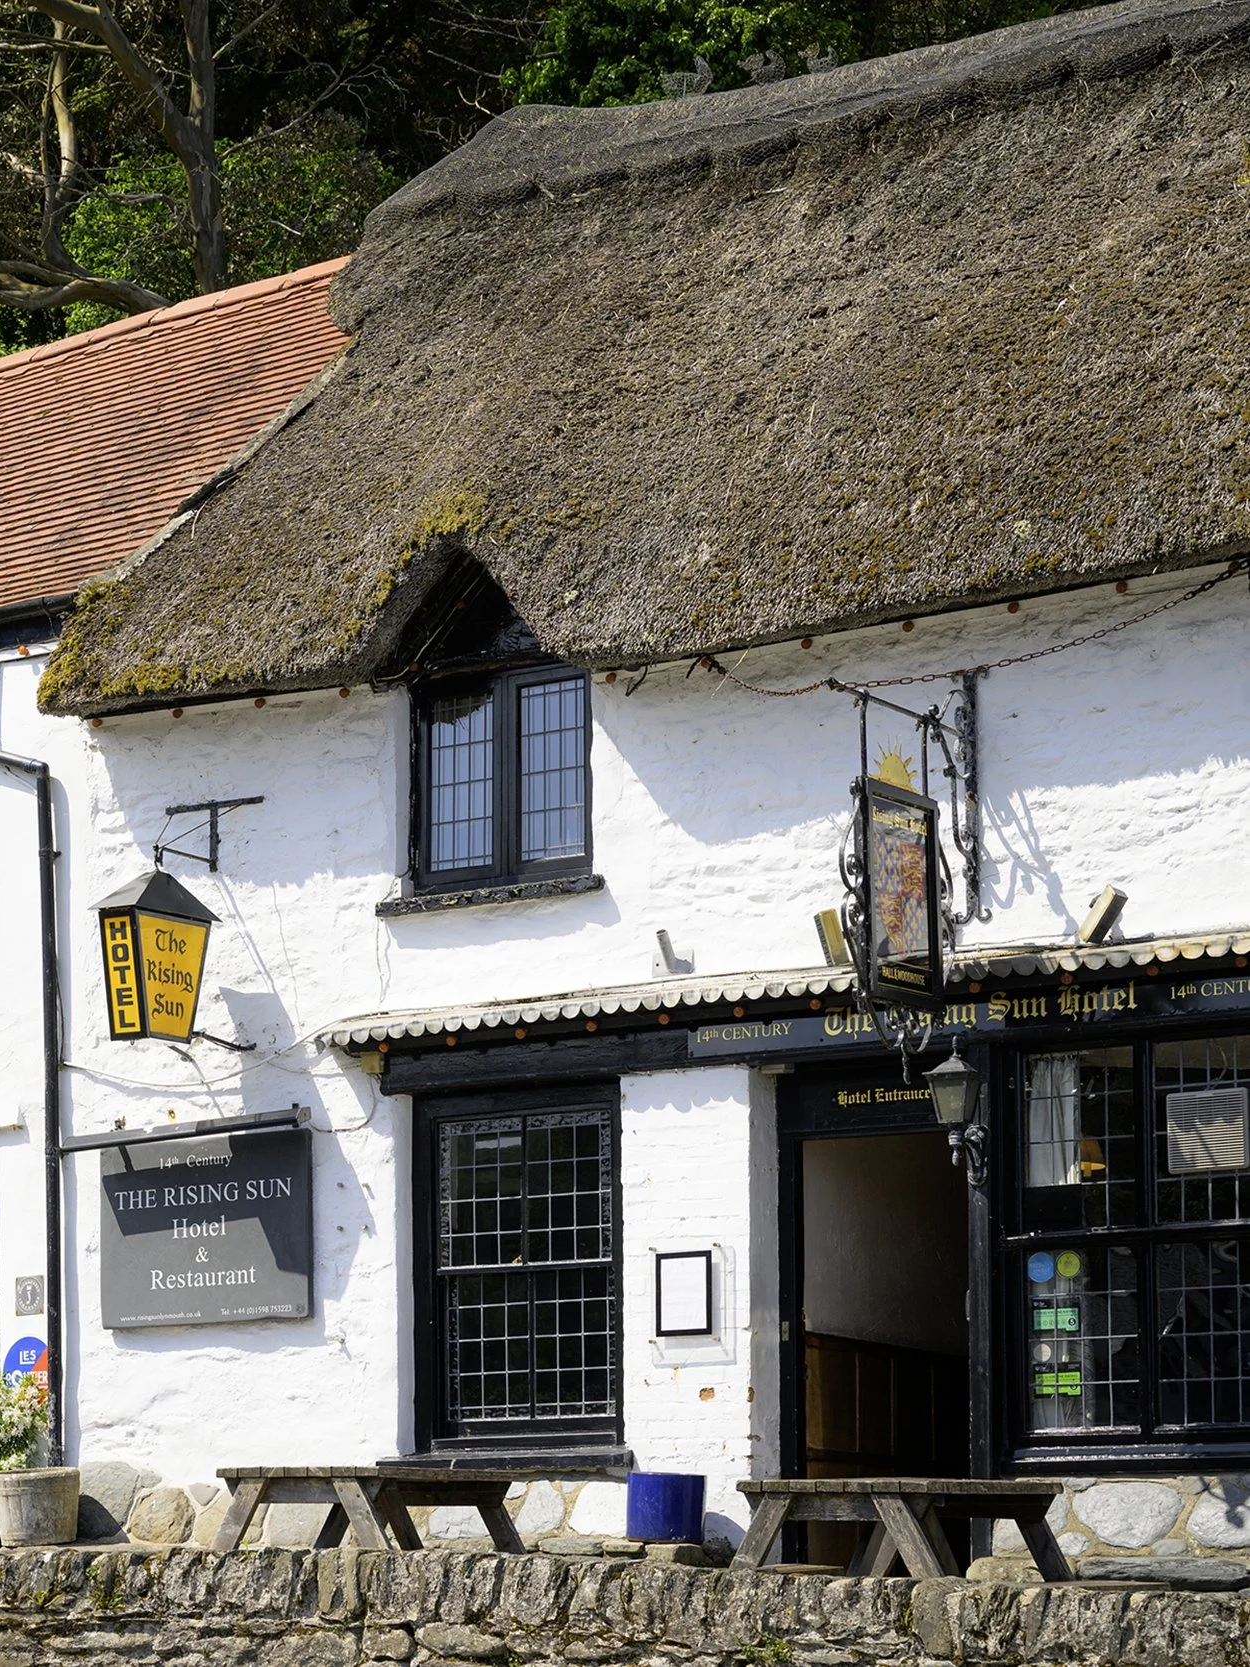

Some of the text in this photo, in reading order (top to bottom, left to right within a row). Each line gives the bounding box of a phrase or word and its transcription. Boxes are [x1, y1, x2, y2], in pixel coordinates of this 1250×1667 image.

[154, 928, 187, 955] The
[109, 920, 136, 1029] HOTEL
[146, 958, 194, 993] Rising
[1170, 979, 1250, 1000] 14th CENT
[151, 992, 185, 1020] Sun
[824, 1006, 875, 1040] The
[986, 990, 1048, 1022] Sun
[1057, 980, 1138, 1022] Hotel
[696, 1022, 792, 1043] 14th CENTURY
[837, 1087, 931, 1108] Hotel Entrance
[159, 1153, 234, 1170] 14th Century
[114, 1177, 293, 1211] THE RISING SUN
[171, 1214, 227, 1240] Hotel
[195, 1246, 210, 1263] &
[150, 1265, 257, 1290] Restaurant
[19, 1349, 37, 1365] LES
